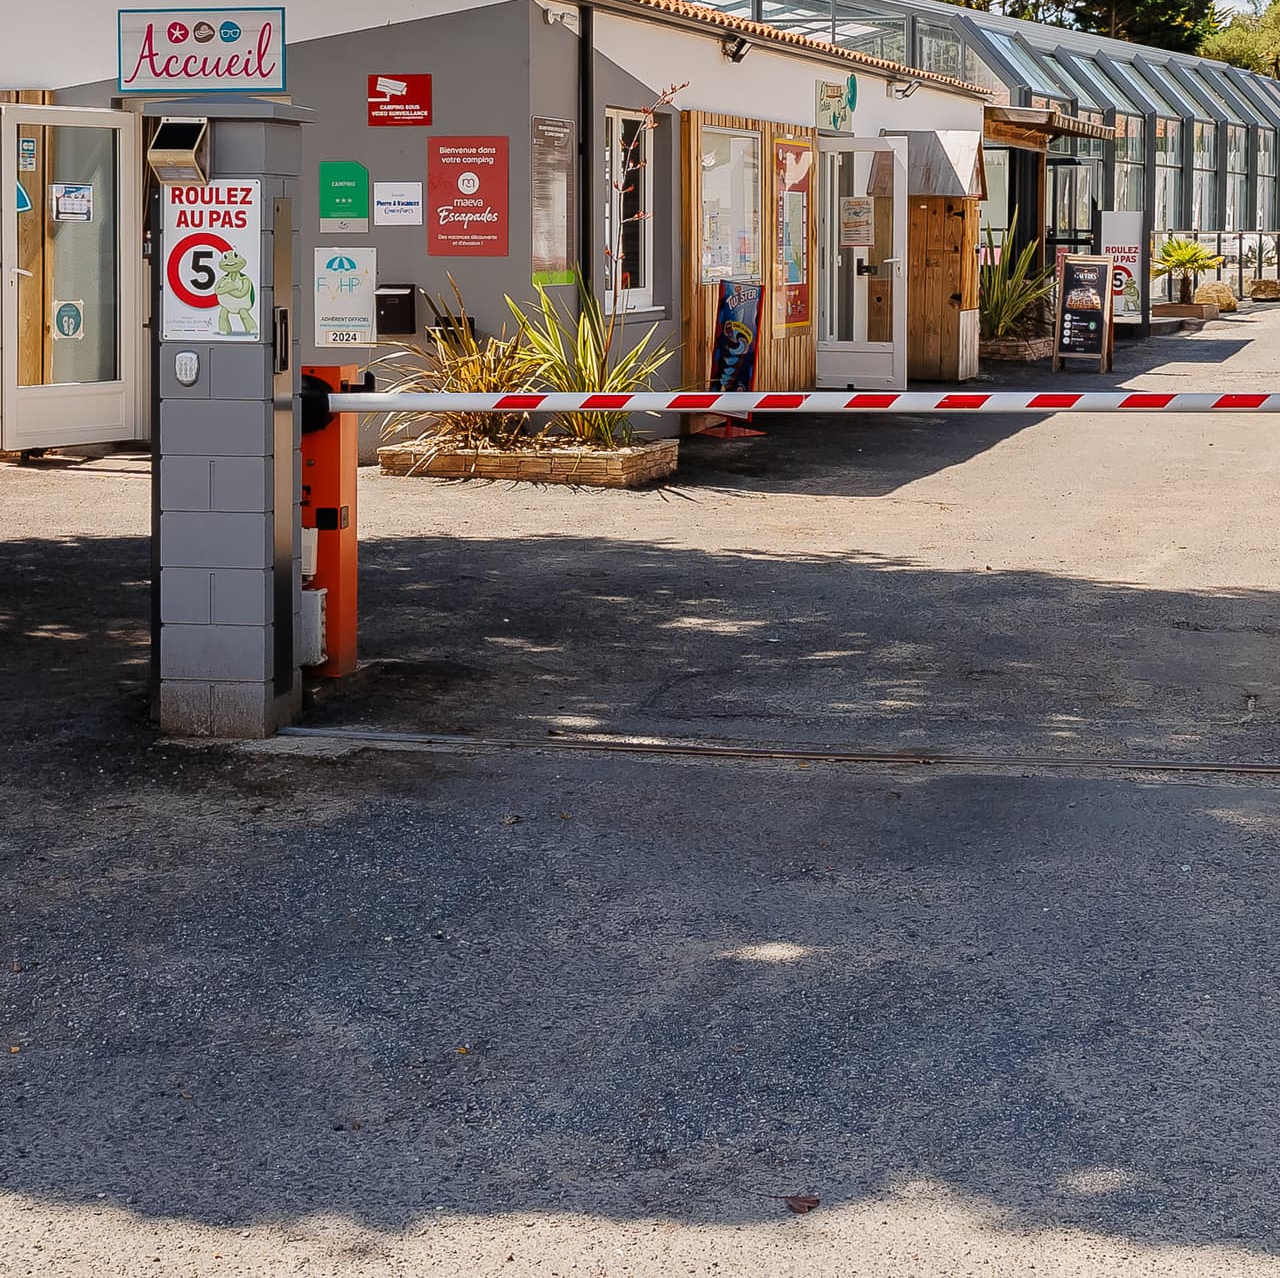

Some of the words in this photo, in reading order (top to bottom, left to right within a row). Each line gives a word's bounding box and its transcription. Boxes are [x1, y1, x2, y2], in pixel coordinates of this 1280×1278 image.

[123, 21, 276, 84] Accueil
[439, 146, 477, 154] Bienvenue
[477, 146, 497, 154] dans
[462, 155, 494, 165] camping
[171, 186, 253, 205] ROULEZ
[453, 198, 484, 207] maeva
[176, 209, 204, 228] AU
[208, 209, 248, 229] PAS
[437, 206, 499, 230] Escapades
[1105, 246, 1140, 254] ROULEZ
[1120, 255, 1137, 263] PAS
[190, 250, 216, 291] 5
[1113, 272, 1123, 289] 5
[332, 332, 358, 342] 2024
